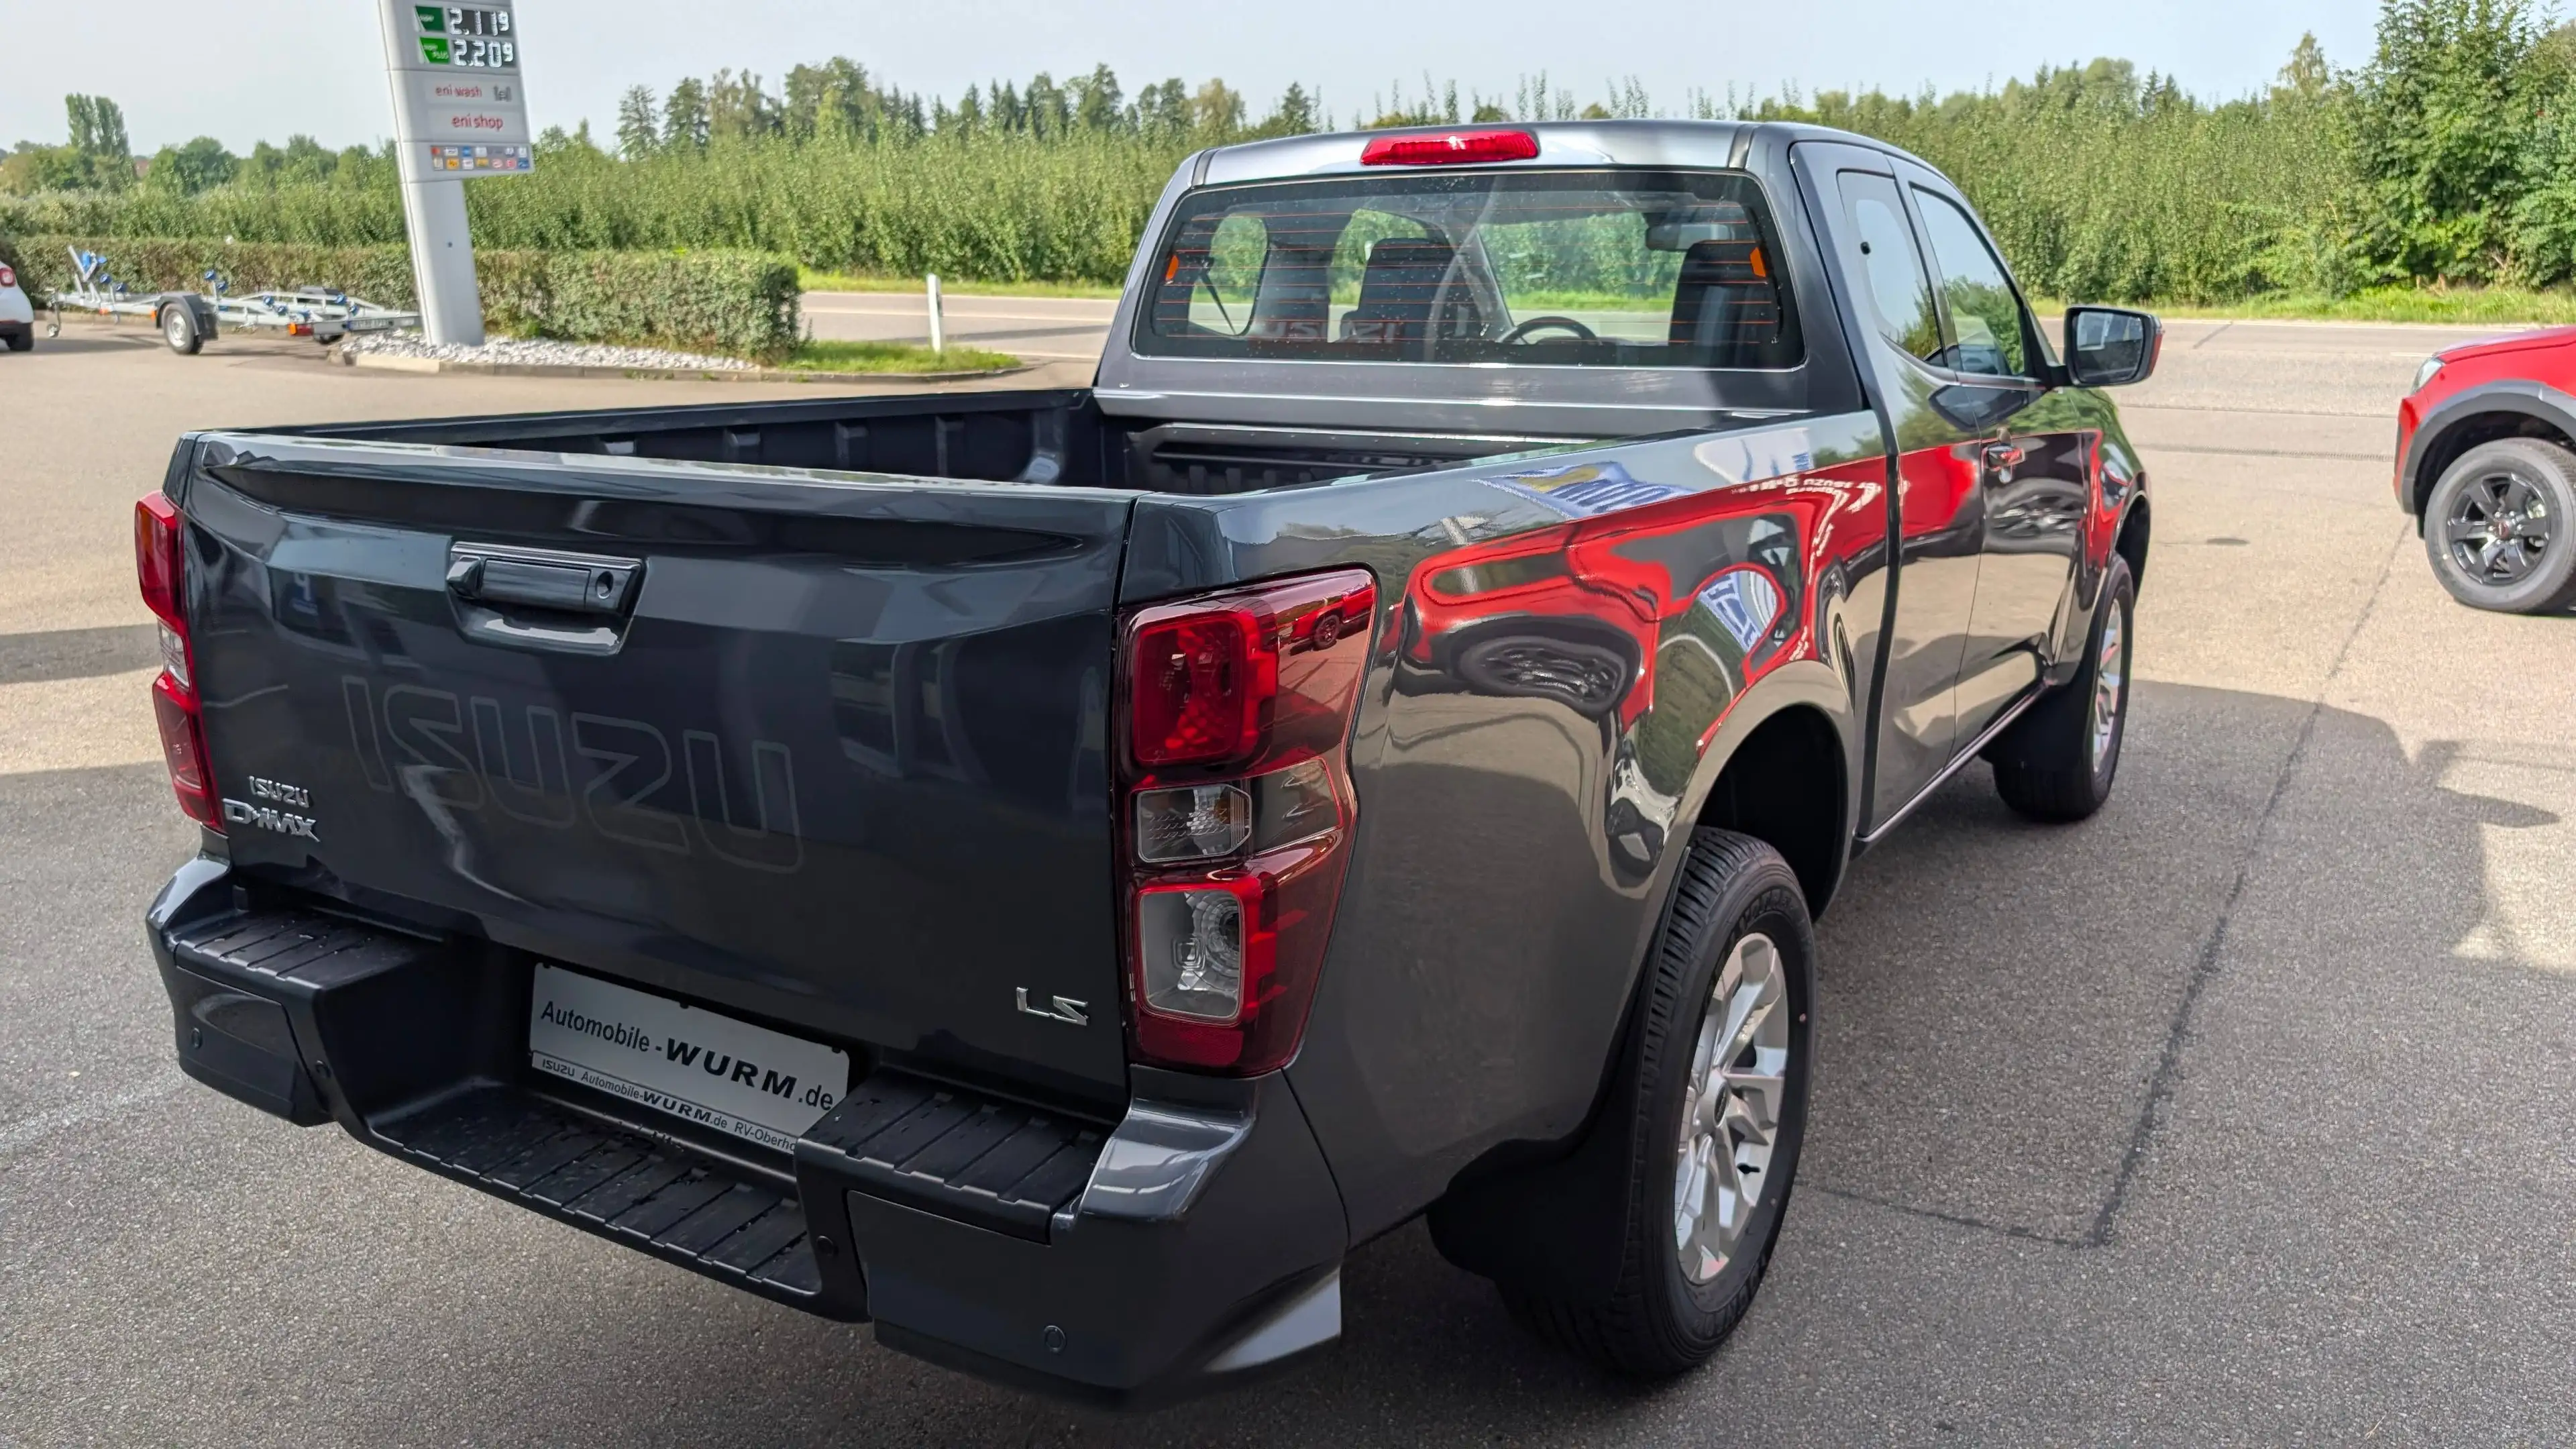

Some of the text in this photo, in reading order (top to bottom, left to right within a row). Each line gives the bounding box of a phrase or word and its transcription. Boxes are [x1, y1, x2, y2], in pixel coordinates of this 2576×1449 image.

[435, 84, 482, 98] eni wash
[451, 113, 503, 132] eni shop
[341, 675, 805, 873] ISUZU
[248, 775, 310, 809] ISUZU
[1016, 987, 1089, 1026] LS
[542, 1059, 576, 1077] ISUZU
